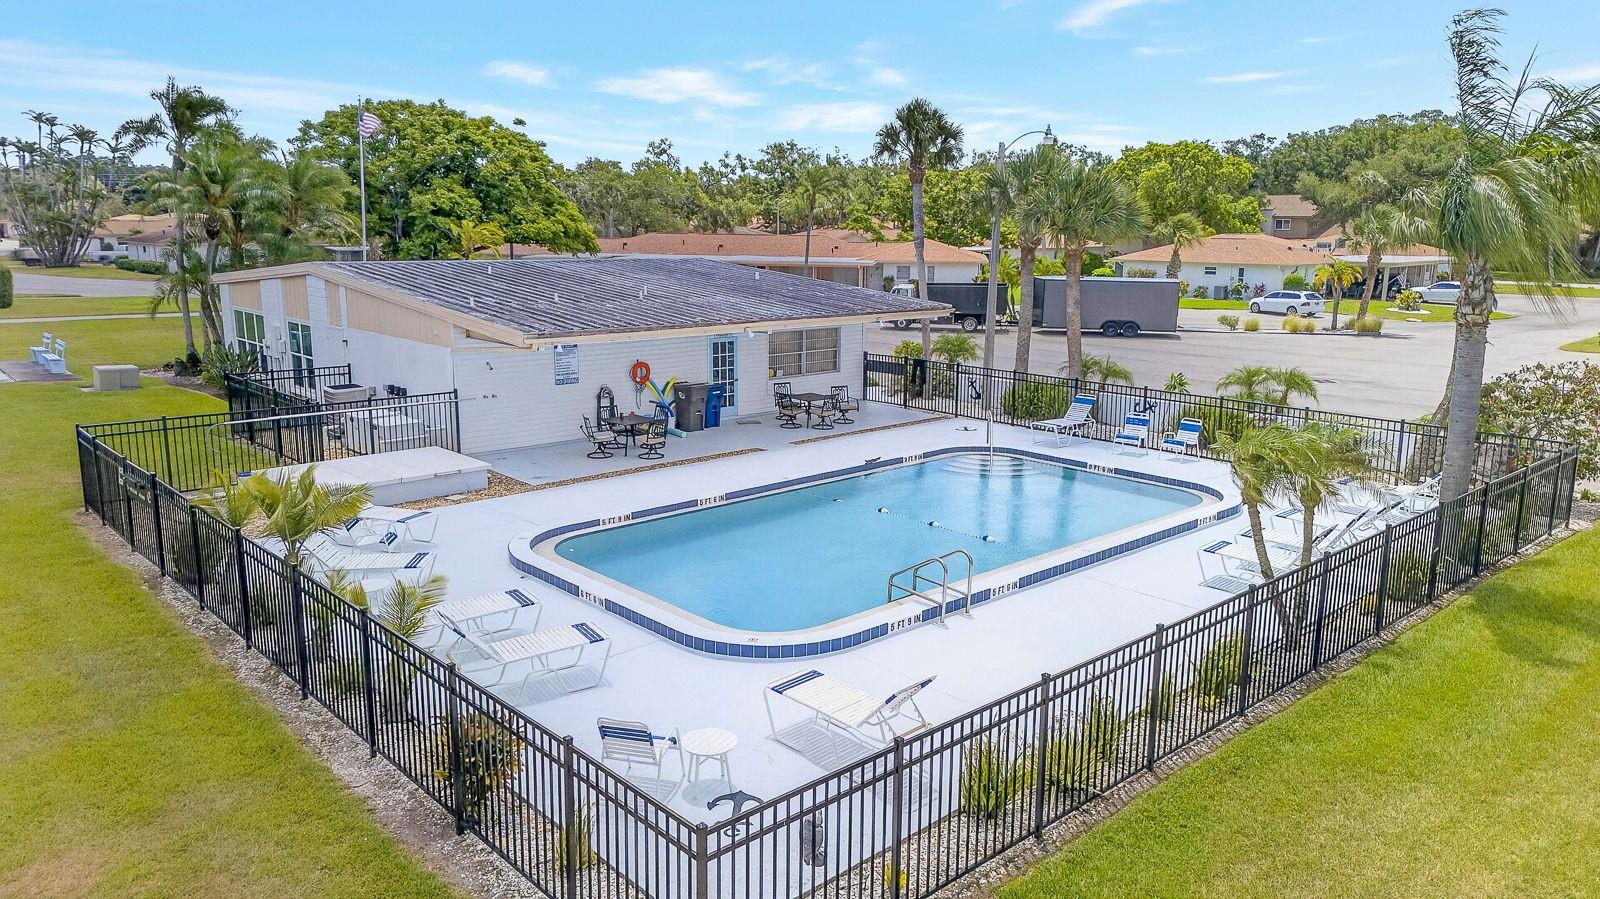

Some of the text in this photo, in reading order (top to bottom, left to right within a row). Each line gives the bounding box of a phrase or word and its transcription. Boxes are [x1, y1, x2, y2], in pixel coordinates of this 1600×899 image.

[623, 514, 631, 522] IN
[992, 581, 1018, 596] 5 FT 6 IN
[585, 592, 592, 602] FT
[597, 597, 604, 608] IN
[897, 620, 905, 630] FT
[907, 617, 912, 626] 9
[914, 613, 922, 624] IN
